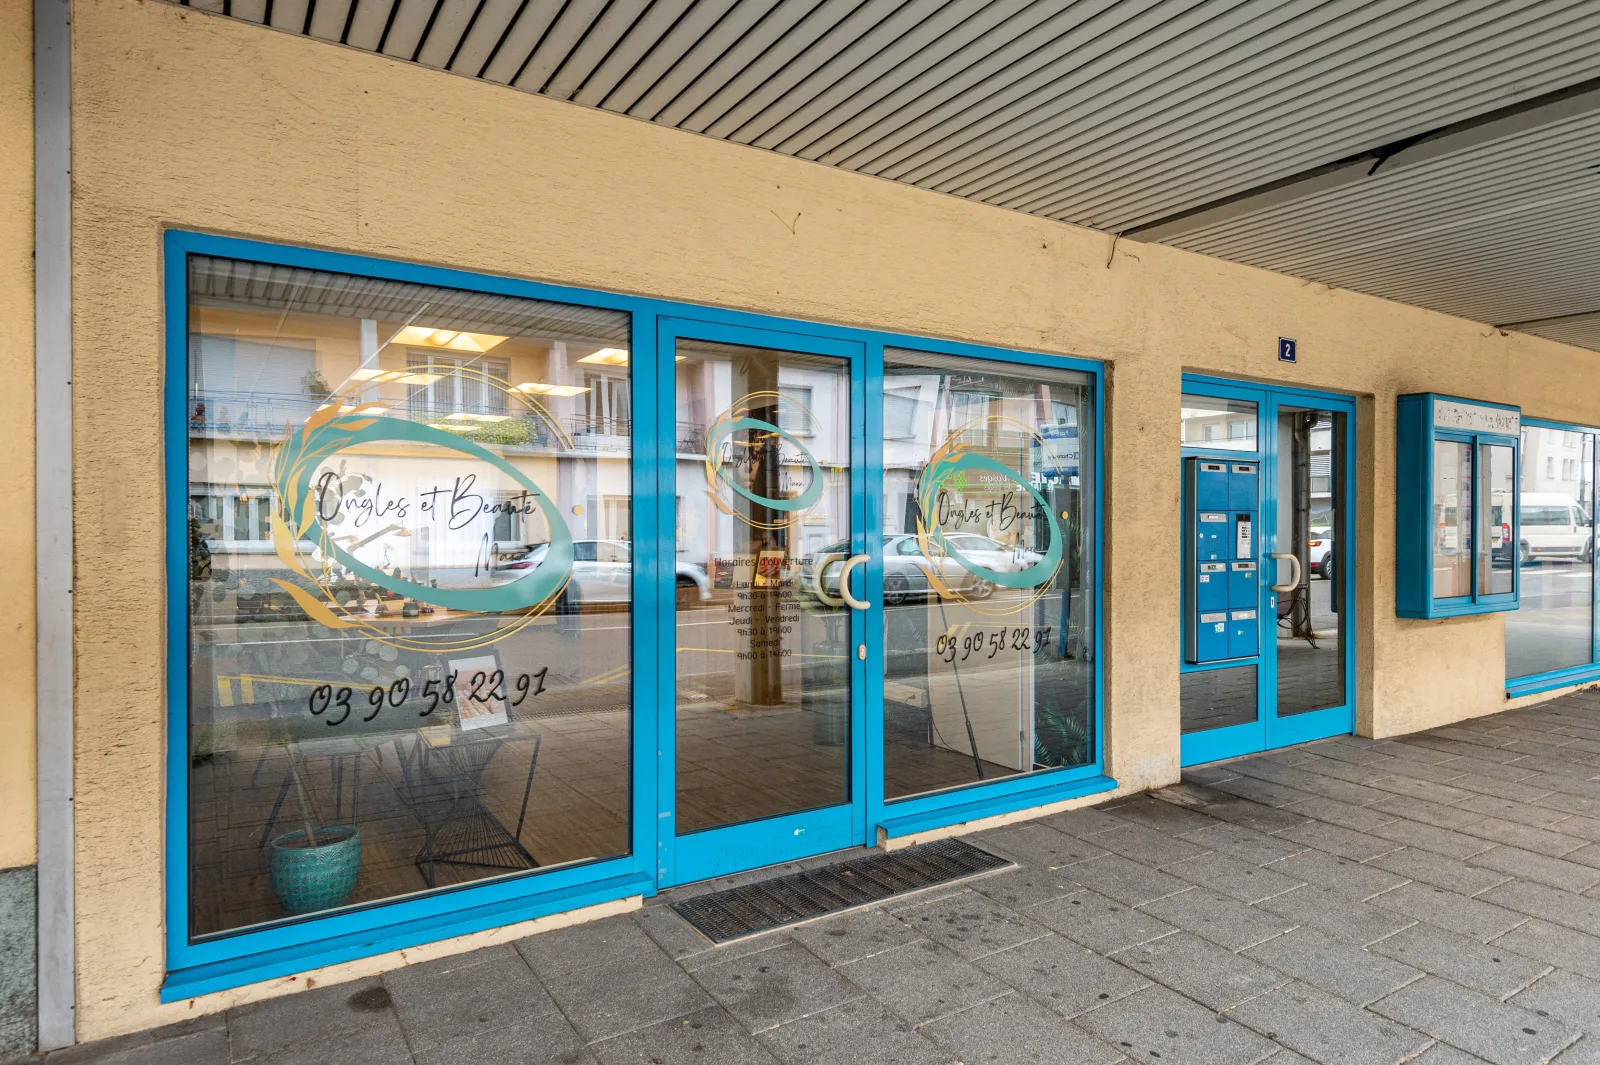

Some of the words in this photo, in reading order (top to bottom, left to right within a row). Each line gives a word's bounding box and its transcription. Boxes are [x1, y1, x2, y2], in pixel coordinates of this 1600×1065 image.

[1285, 343, 1291, 357] 2
[318, 471, 410, 527] Ongles
[420, 486, 453, 521] et
[449, 473, 541, 530] Beauté
[937, 491, 982, 530] Ongles
[985, 501, 1002, 526] et
[714, 557, 756, 567] Horaires
[760, 556, 814, 567] d'ouverture
[737, 591, 758, 600] 9h30
[728, 604, 765, 613] Mercredi
[729, 616, 753, 625] Jeudi
[764, 614, 800, 624] Vendredi
[737, 628, 758, 636] 9h30
[769, 625, 793, 634] 19h00
[936, 631, 957, 663] 03
[961, 630, 985, 661] 90
[987, 626, 1008, 660] 58
[1011, 628, 1031, 652] 22
[1033, 627, 1052, 654] 91
[737, 651, 758, 660] 9h00
[308, 684, 352, 726] 03
[363, 678, 410, 722] 90
[419, 669, 459, 717] 58
[467, 669, 507, 704] 22
[512, 667, 549, 706] 91
